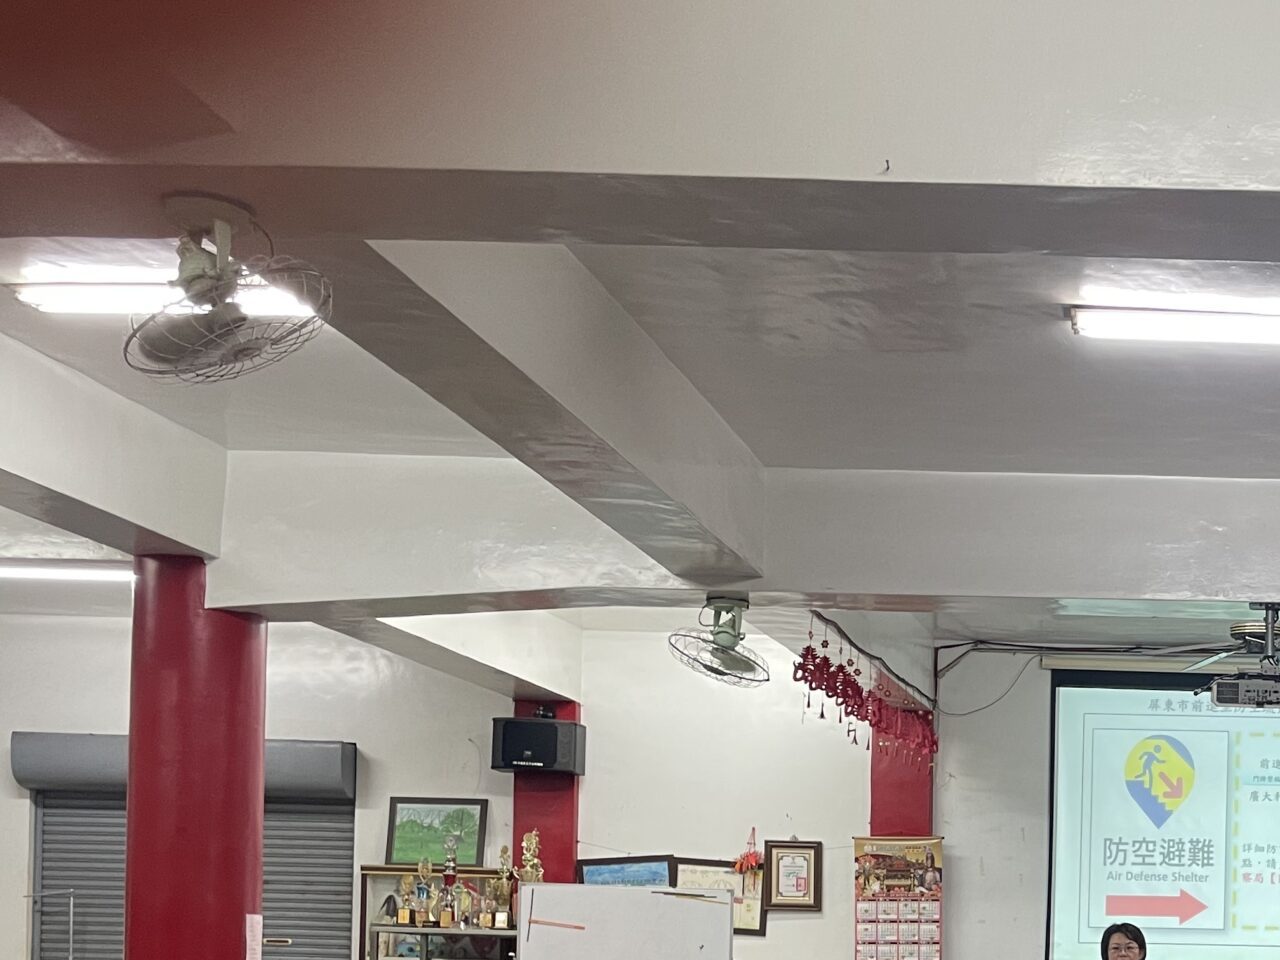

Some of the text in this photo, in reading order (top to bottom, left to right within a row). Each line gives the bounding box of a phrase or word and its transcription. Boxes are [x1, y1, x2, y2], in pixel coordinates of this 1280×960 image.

[1103, 837, 1214, 868] 防空避難
[1106, 871, 1209, 883] Air Defense Shelter
